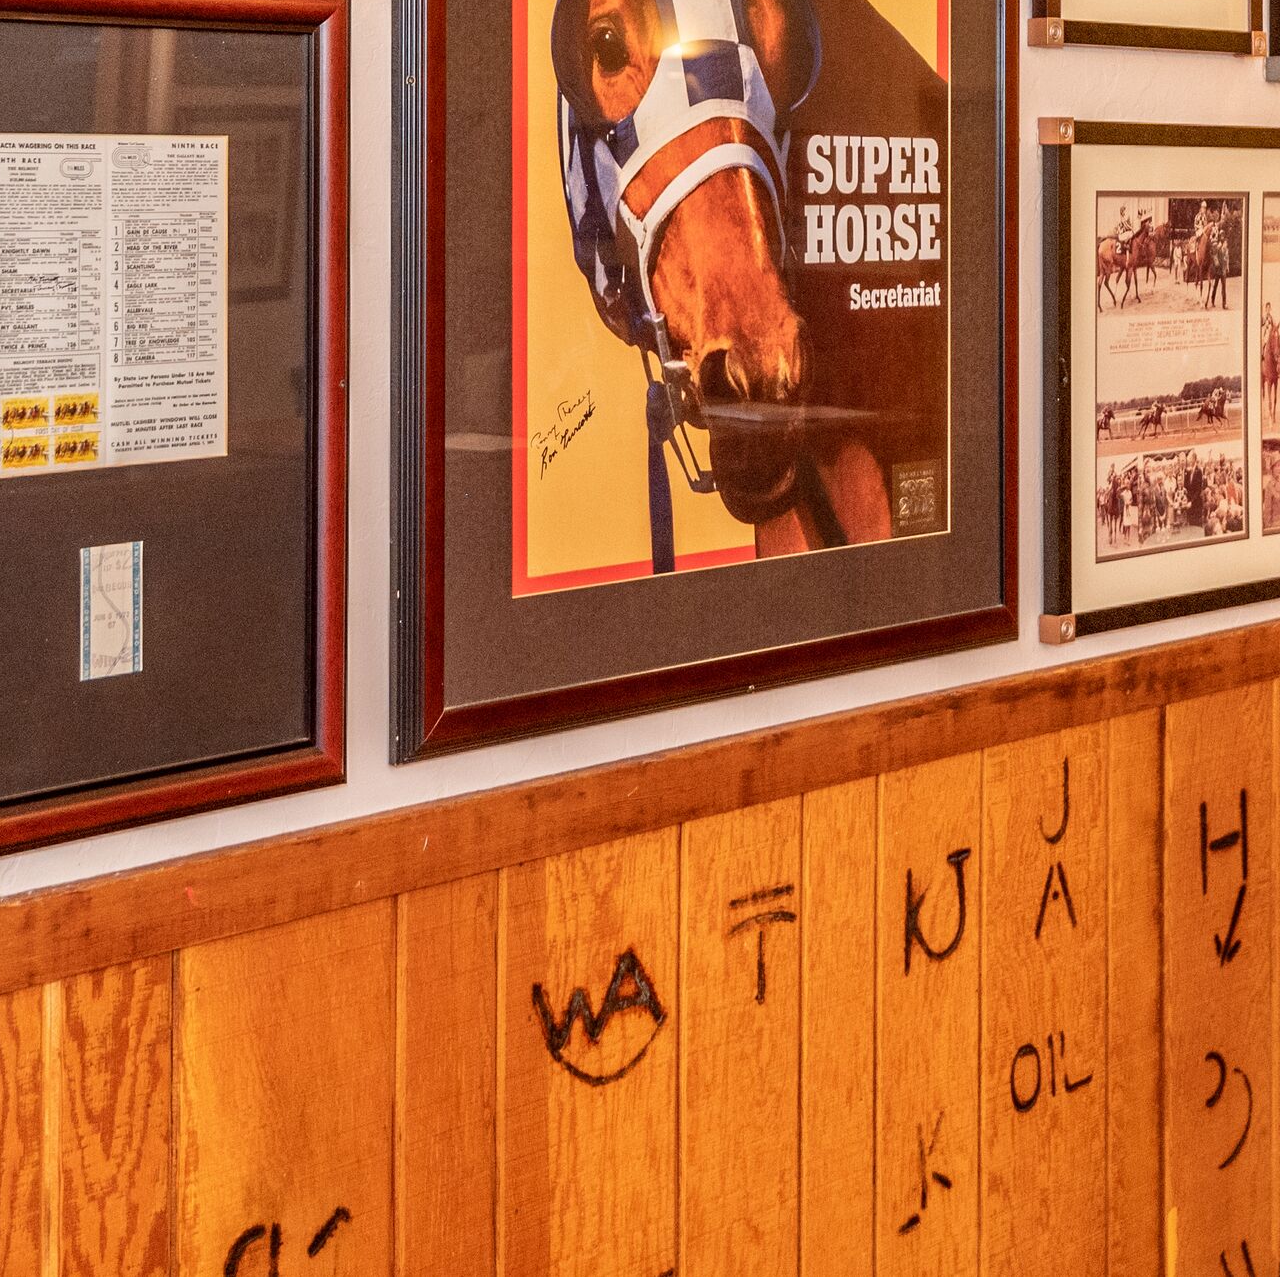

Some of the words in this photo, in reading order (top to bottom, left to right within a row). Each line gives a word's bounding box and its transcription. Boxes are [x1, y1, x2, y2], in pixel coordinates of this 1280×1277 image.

[807, 135, 940, 194] SUPER
[804, 204, 940, 264] HORSE
[850, 281, 940, 310] Secretariat
[1038, 757, 1072, 846] J
[1199, 788, 1248, 895] H
